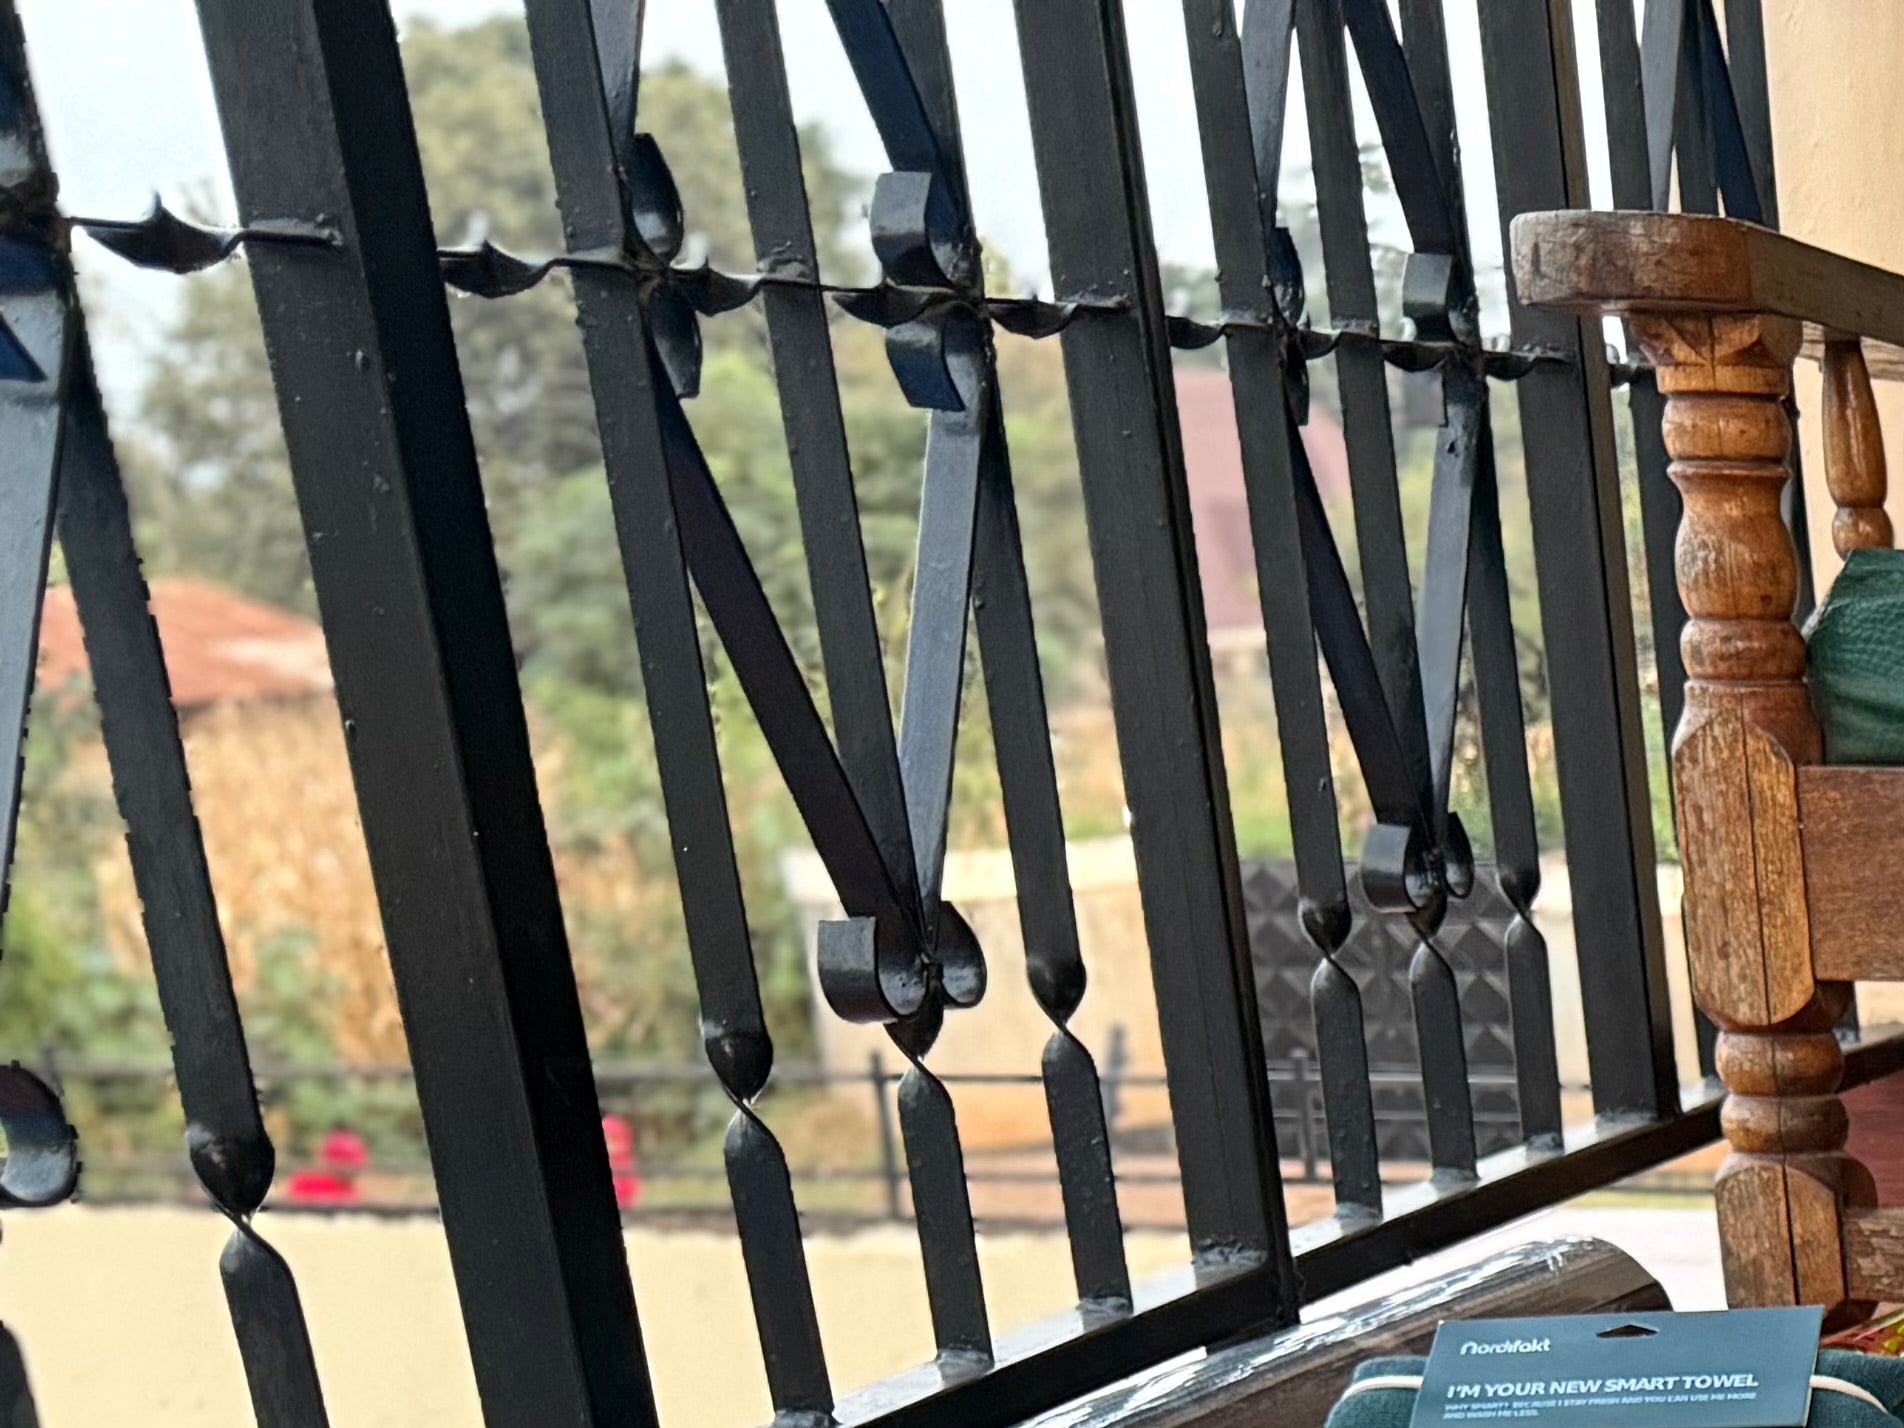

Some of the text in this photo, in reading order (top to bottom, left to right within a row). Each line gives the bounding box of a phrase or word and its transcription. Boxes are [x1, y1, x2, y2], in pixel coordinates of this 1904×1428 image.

[1447, 1373, 1760, 1399] I'M YOUR NEW SMART TOWEL
